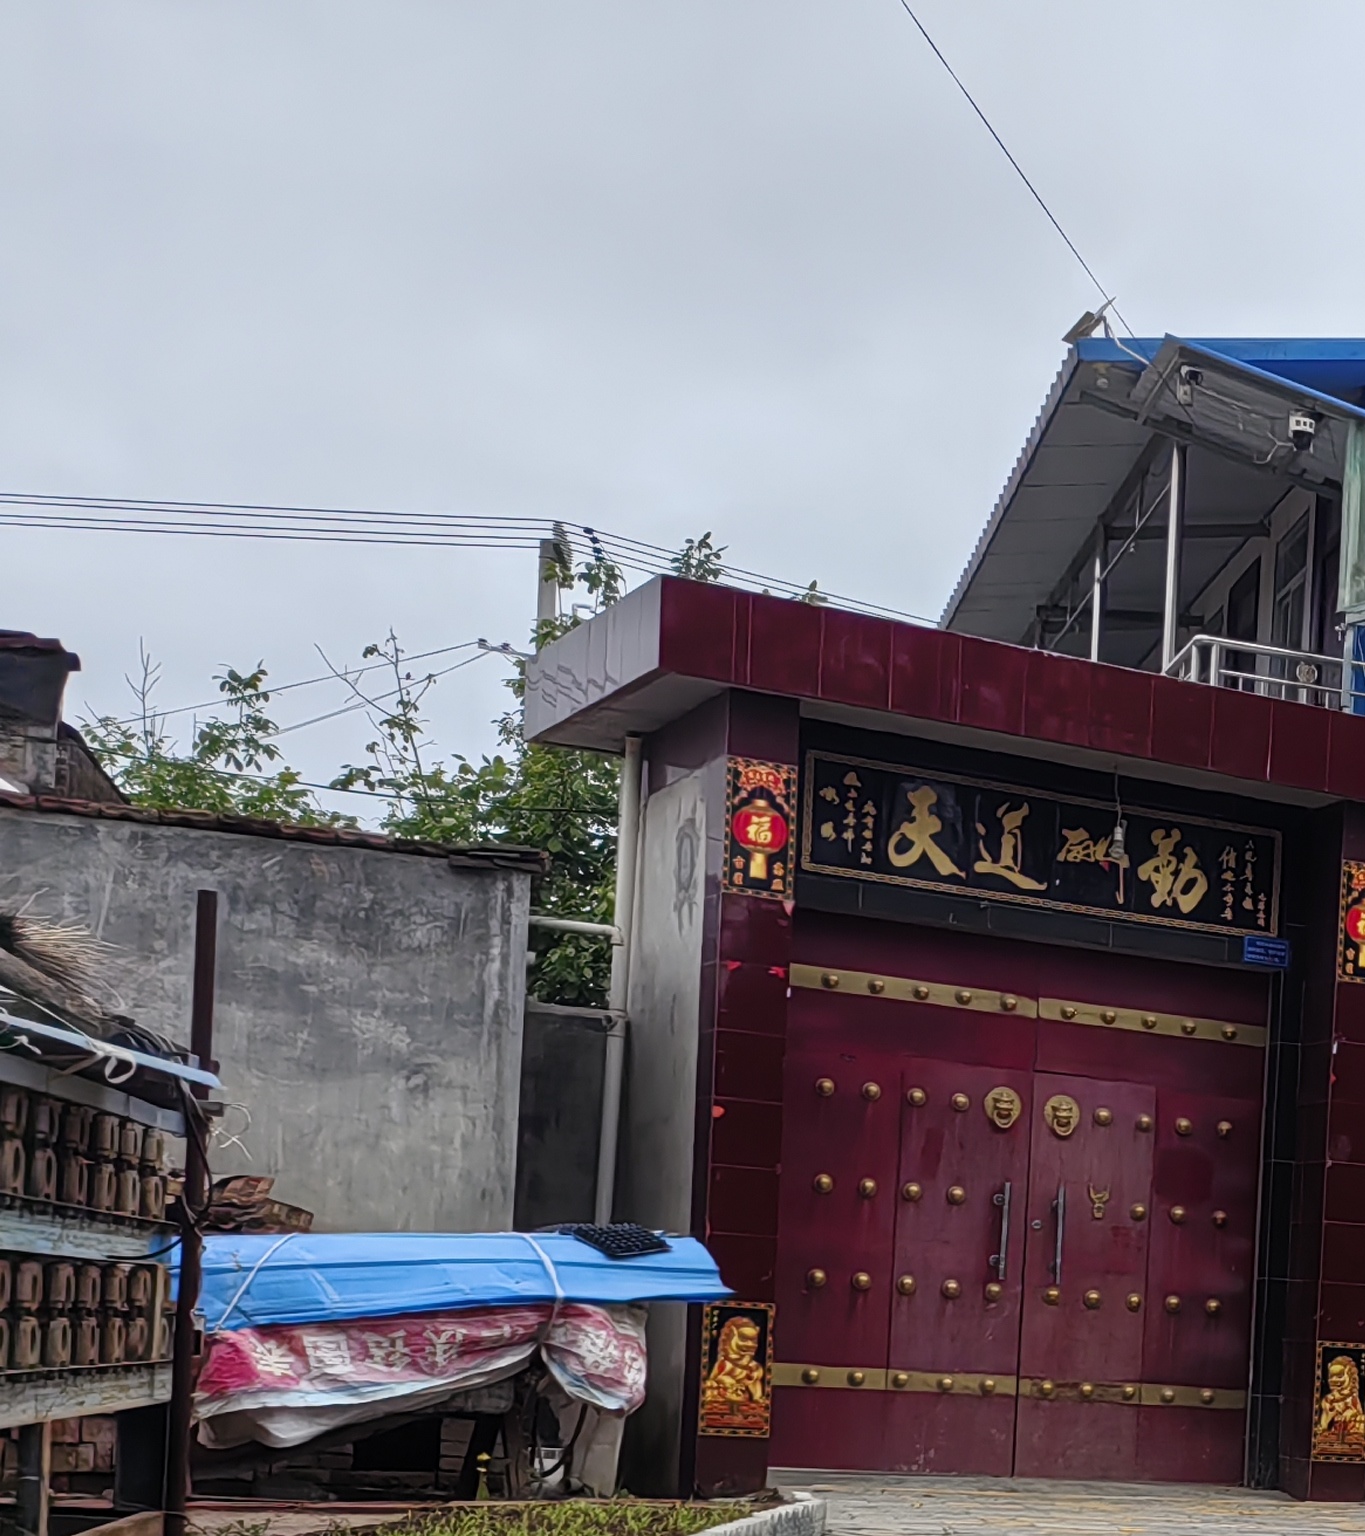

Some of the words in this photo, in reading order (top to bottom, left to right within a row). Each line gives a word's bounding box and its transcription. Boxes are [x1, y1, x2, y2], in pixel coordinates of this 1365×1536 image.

[745, 815, 773, 844] 福
[887, 785, 1209, 915] 天道酬勤
